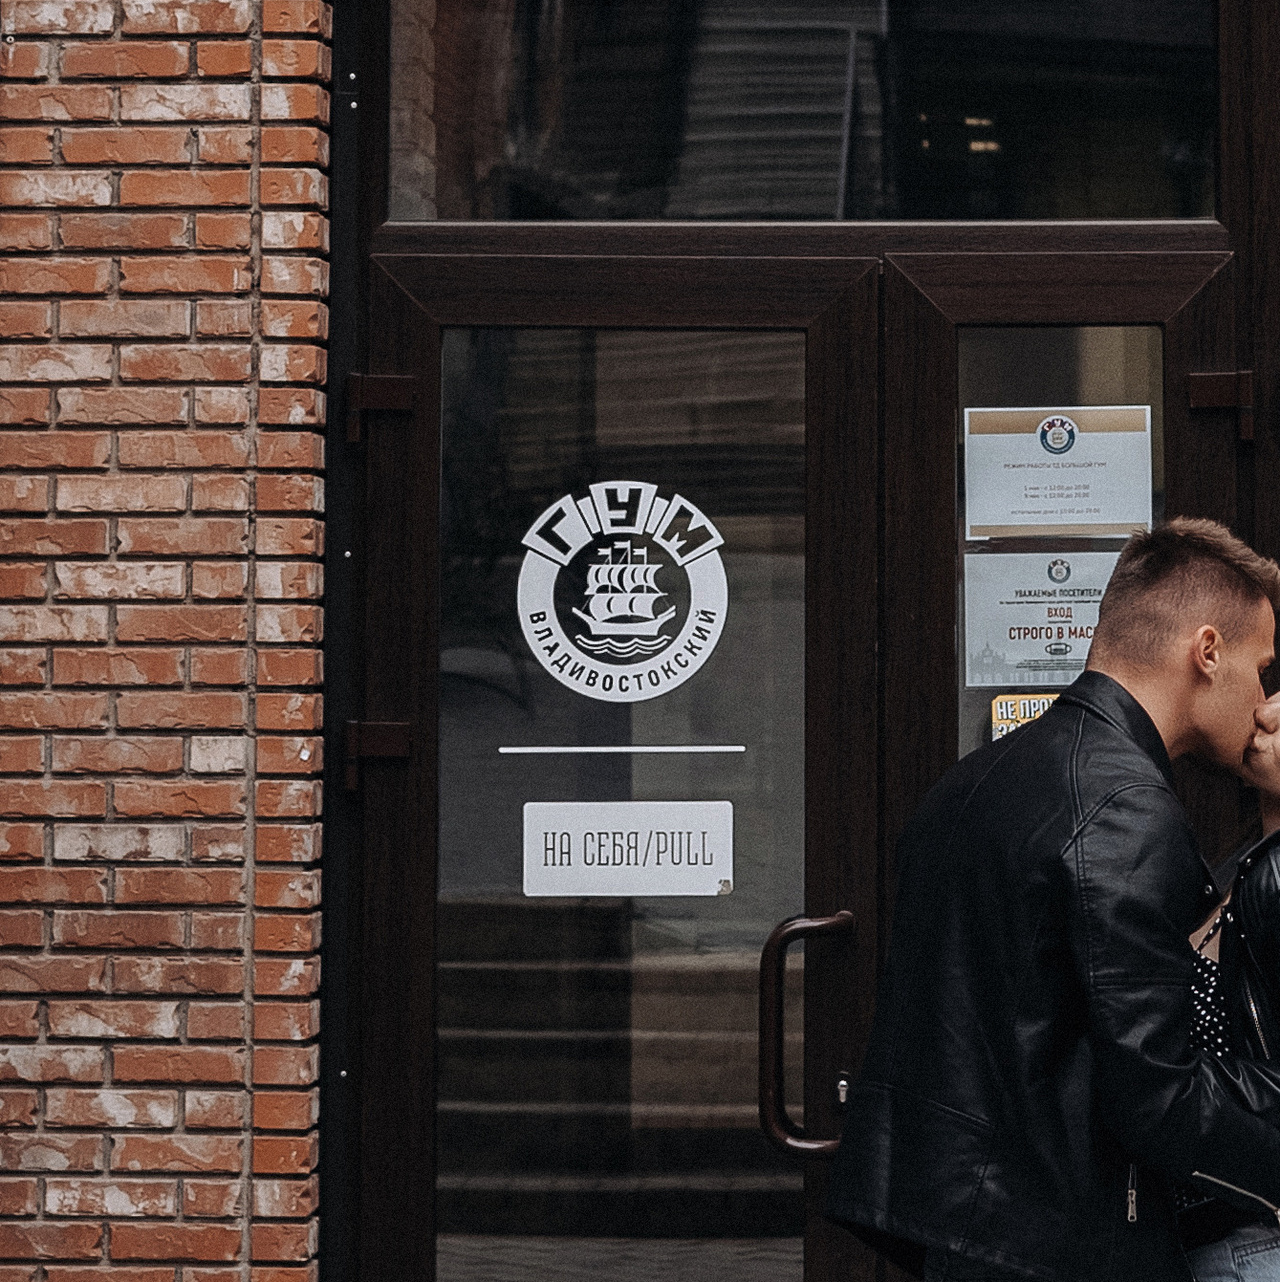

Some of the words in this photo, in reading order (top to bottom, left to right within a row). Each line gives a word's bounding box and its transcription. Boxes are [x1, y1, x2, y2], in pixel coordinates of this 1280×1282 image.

[535, 486, 714, 557] ГУМ
[1015, 589, 1057, 597] УВАЖАЕМЫЕ
[1059, 588, 1102, 597] ПОСЕТИТЕЛИ
[1047, 607, 1073, 619] ВХОД
[1009, 626, 1053, 640] СТРОГО
[1057, 626, 1064, 639] В
[1068, 626, 1095, 639] МАС
[529, 610, 717, 693] ВЛАДИВОСТОКСКИЙ
[997, 701, 1017, 720] НЕ
[543, 830, 573, 867] НА
[583, 830, 714, 867] СЕБЯ/PULL
